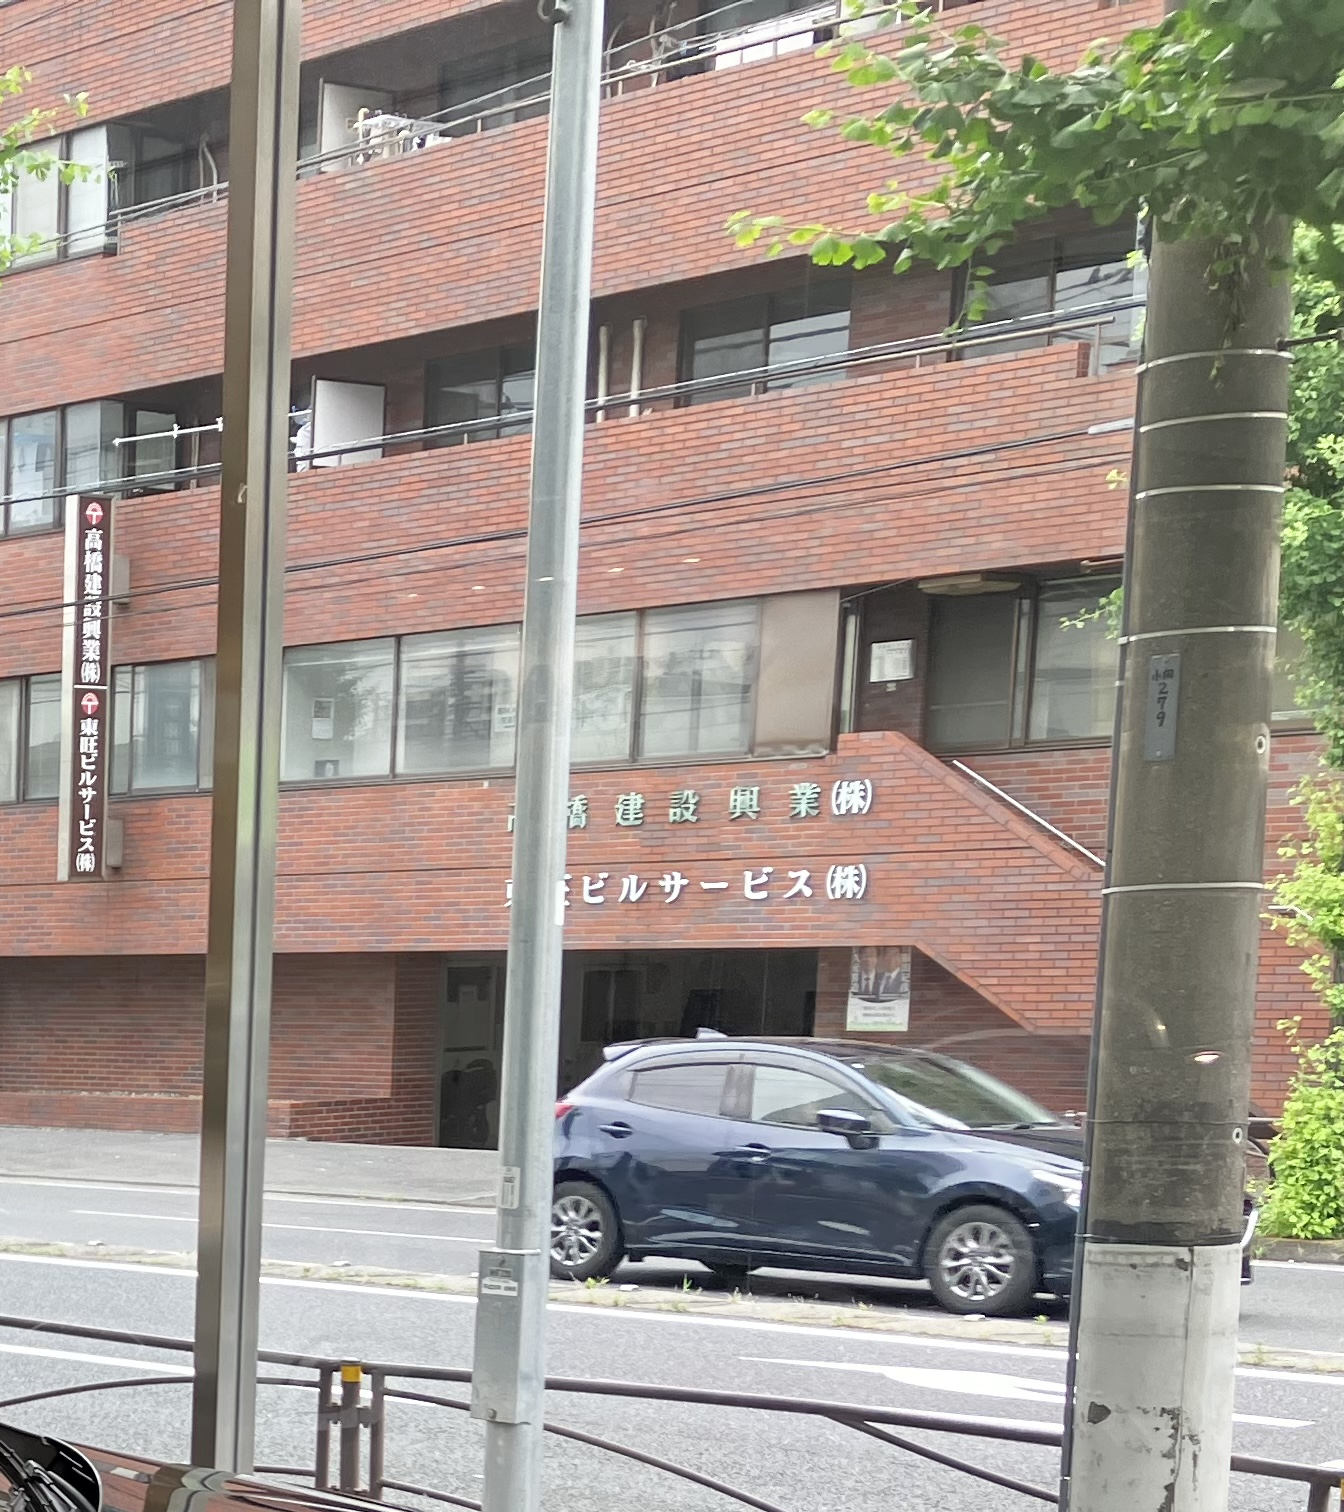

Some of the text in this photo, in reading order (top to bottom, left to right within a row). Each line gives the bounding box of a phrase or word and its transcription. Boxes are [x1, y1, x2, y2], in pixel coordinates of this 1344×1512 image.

[1155, 682, 1169, 728] 279
[507, 779, 873, 833] 橋建設興業(株)
[504, 863, 868, 908] ビルサービス(株)
